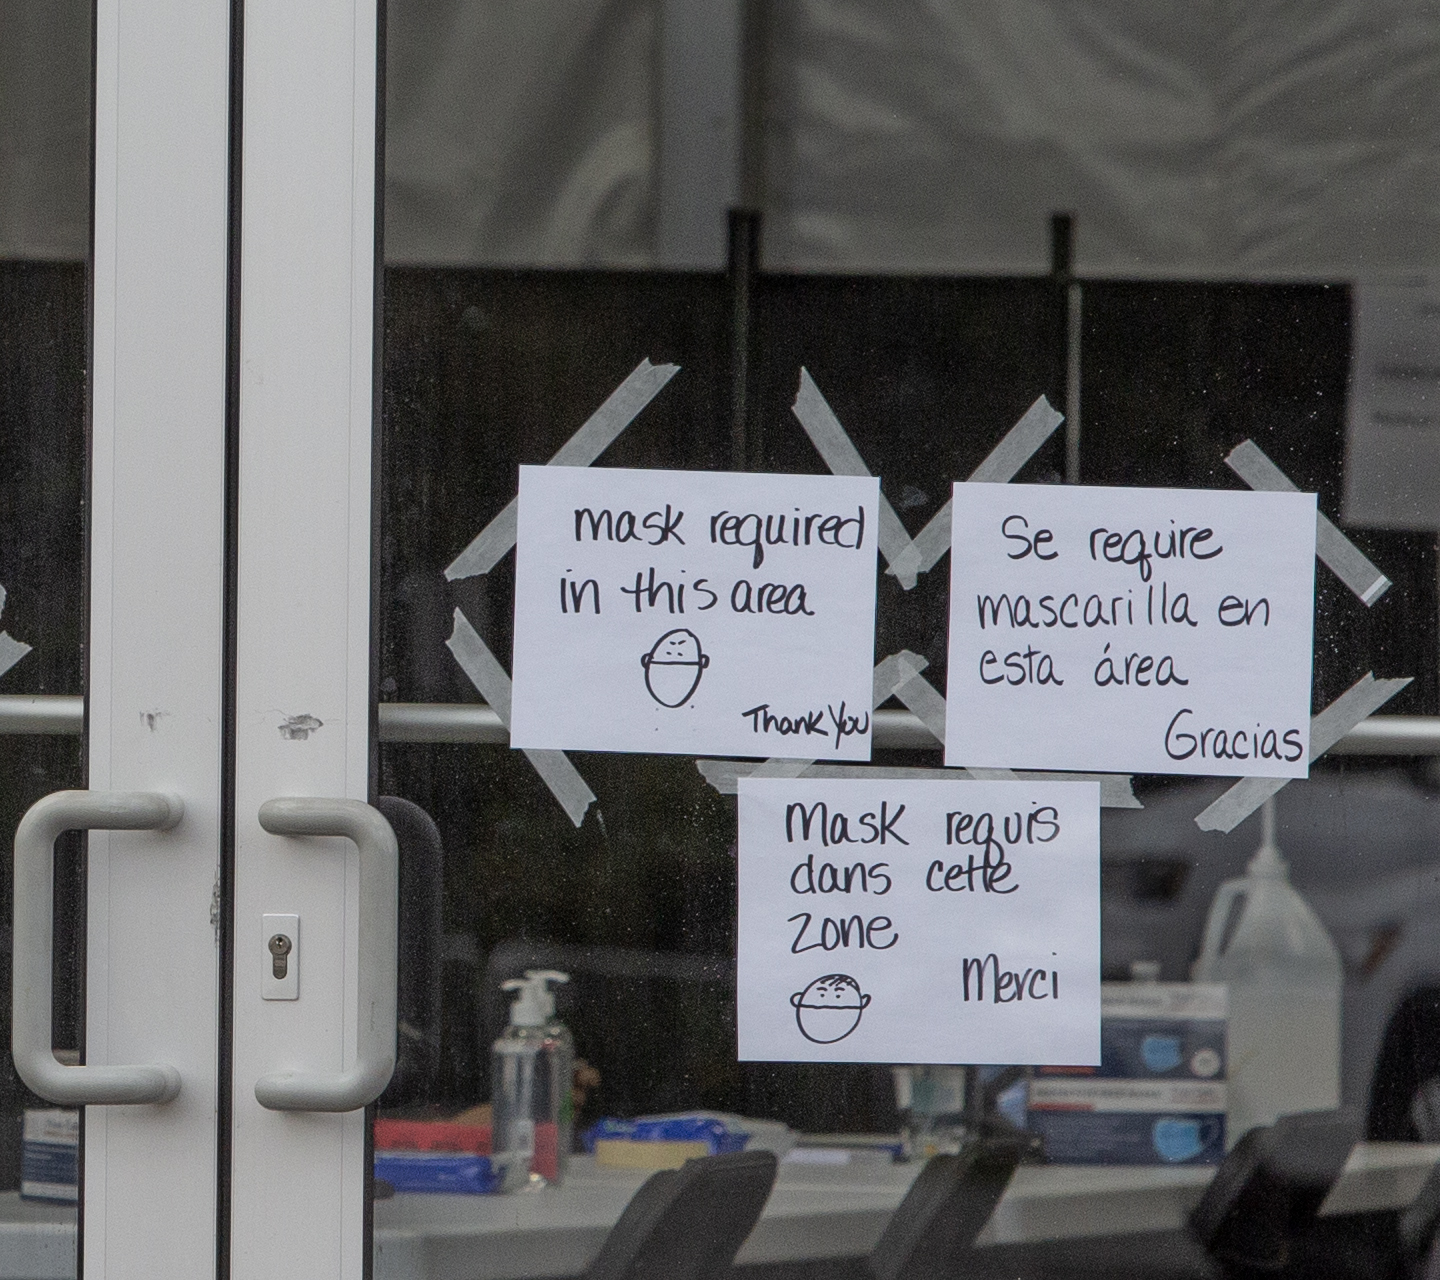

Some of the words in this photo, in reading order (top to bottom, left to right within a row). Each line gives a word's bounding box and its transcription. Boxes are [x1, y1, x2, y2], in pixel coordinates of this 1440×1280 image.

[574, 504, 685, 546] mask
[710, 505, 865, 570] required
[1001, 515, 1059, 561] Se
[560, 569, 601, 615] in
[620, 567, 718, 614] this
[730, 579, 815, 616] area
[977, 578, 1198, 630] mascarilla
[1218, 595, 1270, 627] en
[979, 645, 1064, 686] esta
[1094, 642, 1189, 687] área
[1164, 708, 1303, 762] Gracias
[945, 801, 1061, 869] requis
[790, 854, 892, 895] dans
[926, 851, 1019, 894] cette
